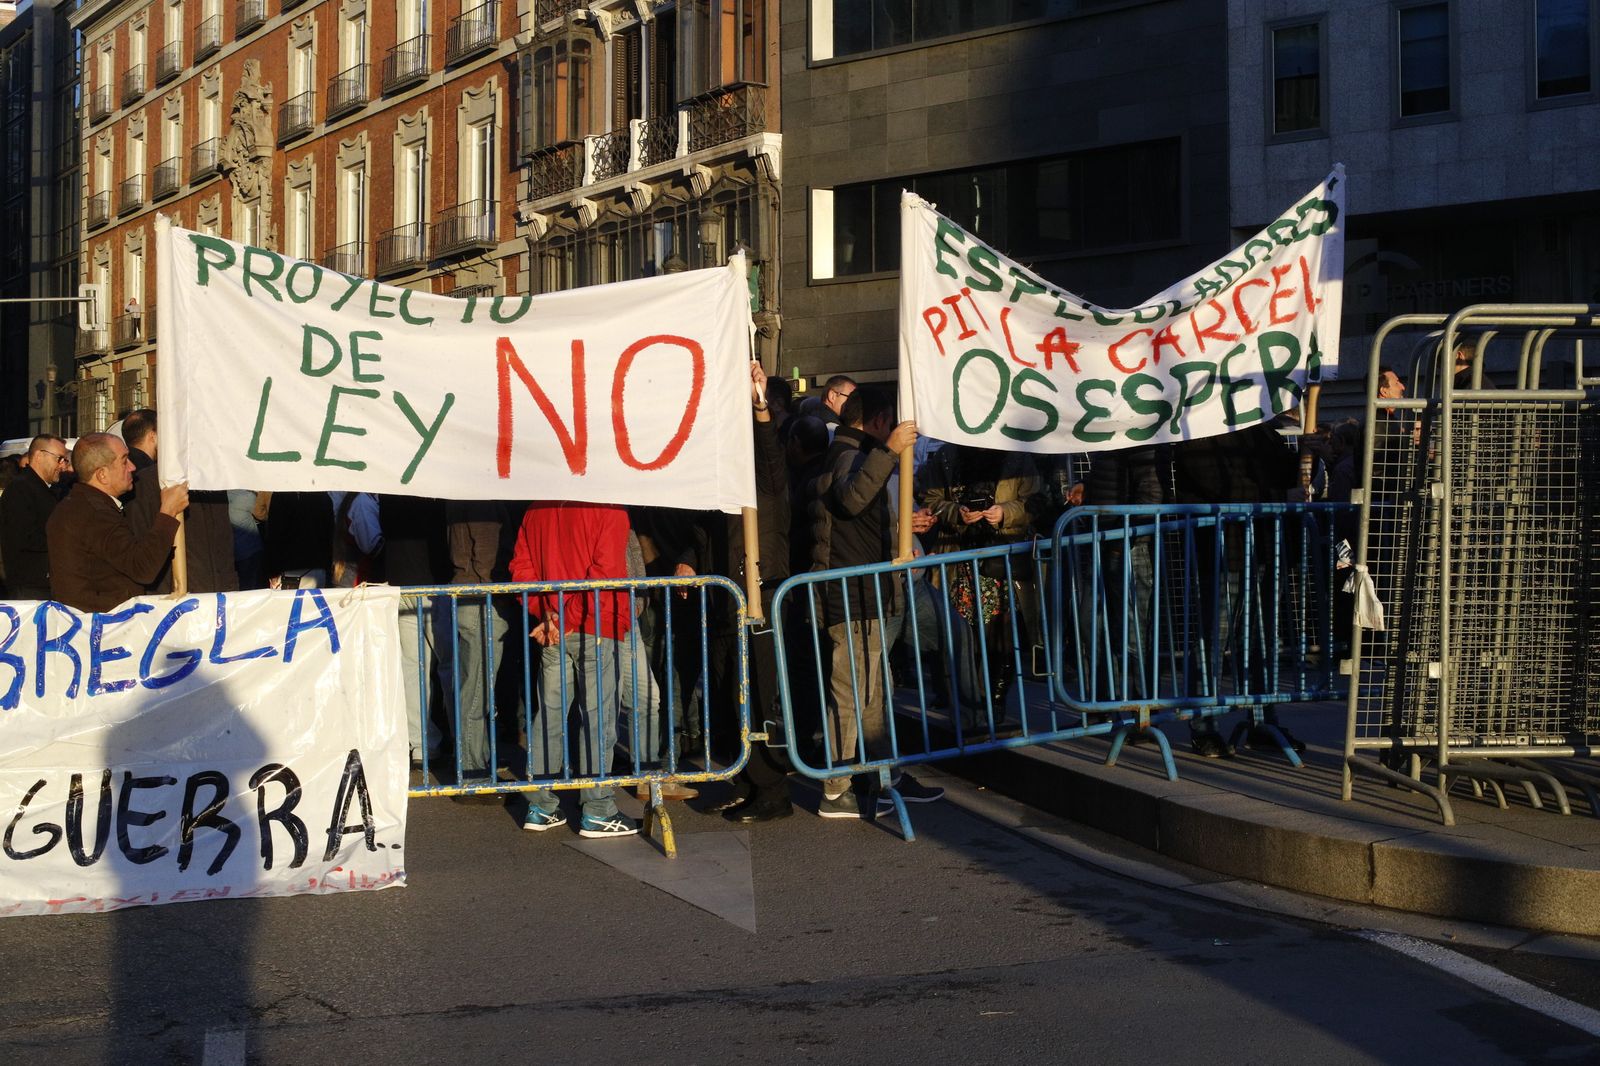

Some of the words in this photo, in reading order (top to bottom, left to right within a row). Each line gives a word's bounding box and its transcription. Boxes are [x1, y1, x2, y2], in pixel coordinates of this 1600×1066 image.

[300, 324, 385, 382] DE
[247, 376, 455, 485] LEY
[496, 334, 706, 479] NO
